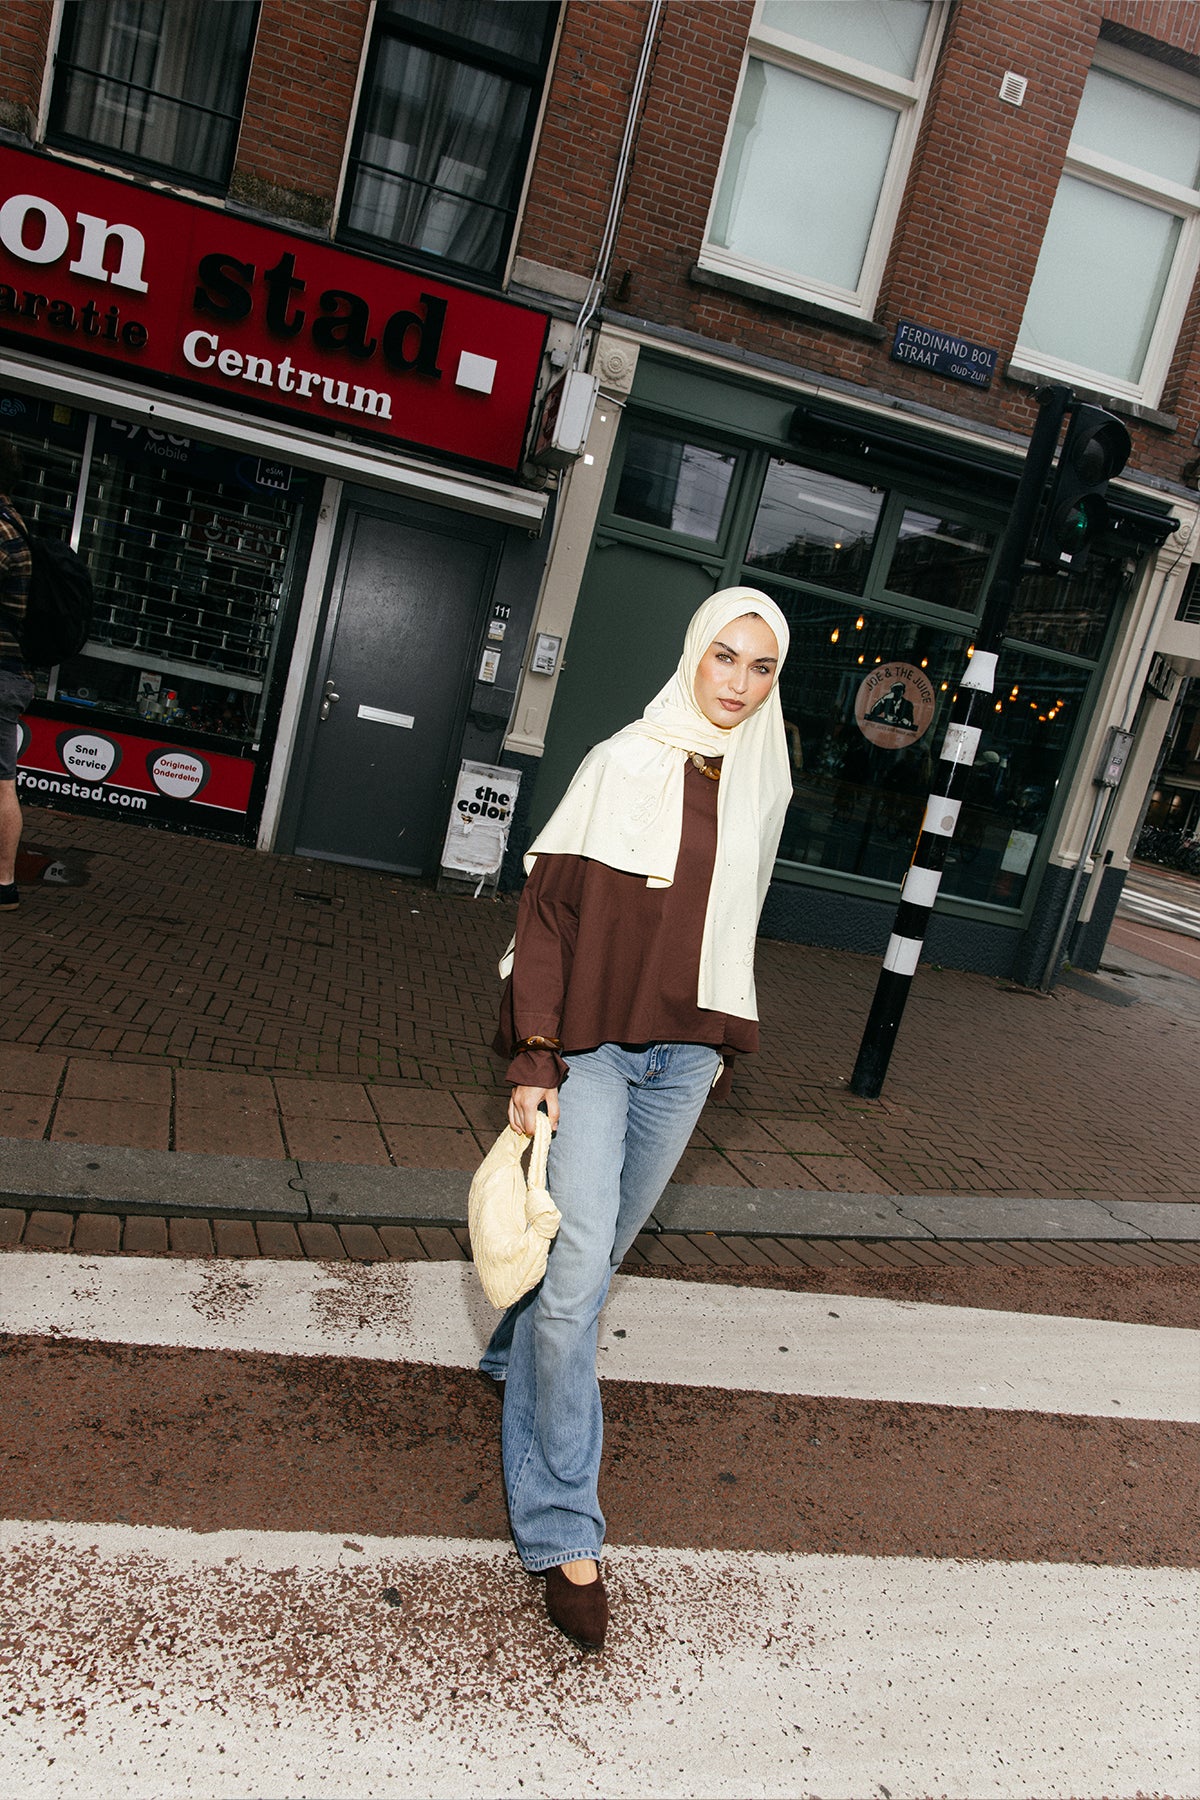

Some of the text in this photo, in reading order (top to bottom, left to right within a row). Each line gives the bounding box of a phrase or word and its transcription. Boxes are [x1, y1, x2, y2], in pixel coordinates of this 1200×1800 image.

[897, 342, 939, 366] STRAAT
[900, 325, 992, 367] FERDINAND BOL
[183, 329, 392, 420] Centrum
[144, 441, 188, 461] Mobile
[265, 467, 284, 477] eSIM
[204, 521, 274, 554] OPEN
[495, 605, 510, 618] 111
[865, 667, 931, 704] JOE & THE JUICE
[75, 744, 98, 756] Snel
[68, 756, 107, 771] Service
[160, 759, 197, 772] Originele
[153, 768, 200, 783] Onderdelen
[475, 786, 510, 805] the
[457, 800, 511, 821] color
